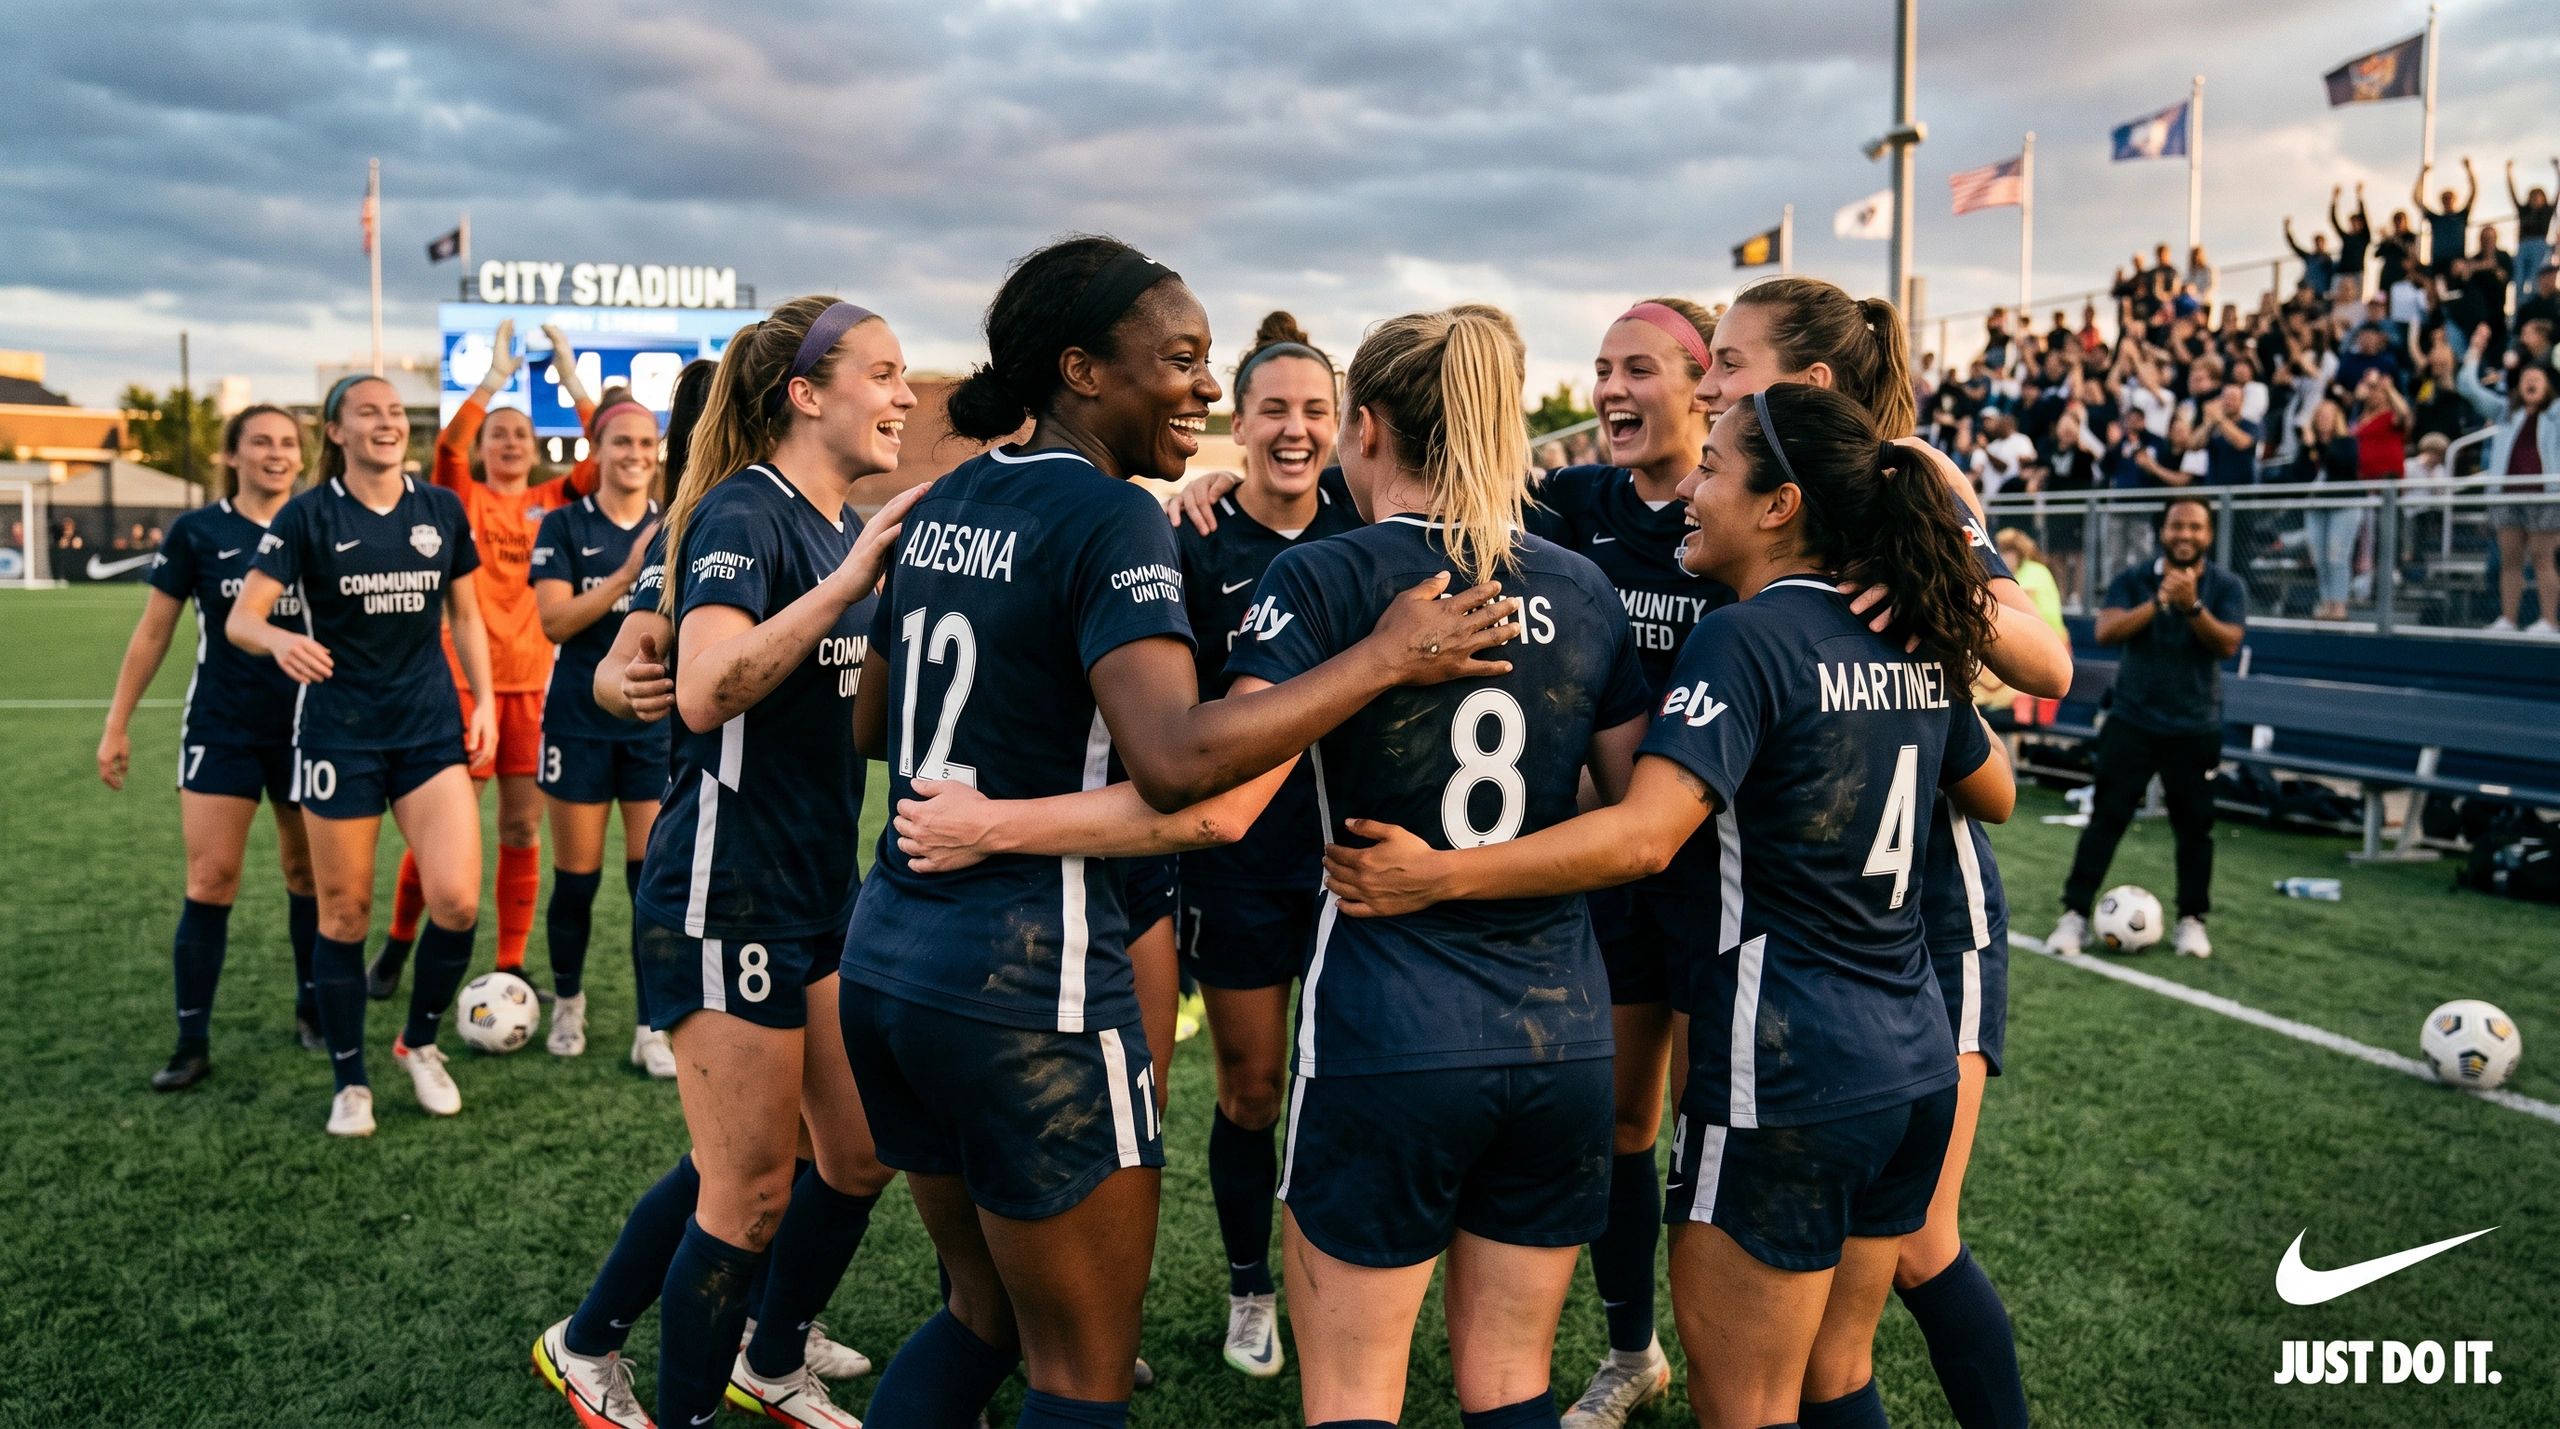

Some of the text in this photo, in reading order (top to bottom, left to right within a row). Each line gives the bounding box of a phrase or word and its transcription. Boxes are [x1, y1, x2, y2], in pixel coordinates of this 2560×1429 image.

[479, 260, 737, 309] CITY STADIUM
[692, 551, 755, 573] COMMUNITY
[900, 520, 1017, 582] ADESINA
[340, 571, 441, 596] COMMUNITY
[699, 565, 736, 583] UNITED
[1111, 564, 1182, 589] COMMUNITY
[1131, 582, 1179, 603] UNITED
[364, 592, 425, 615] UNITED
[1240, 595, 1295, 641] ely
[1616, 587, 1707, 624] MUNITY
[899, 607, 977, 790] 12
[1663, 680, 1728, 727] ely
[1817, 662, 1950, 712] MARTINEZ
[187, 746, 205, 780] 7
[303, 760, 337, 800] 10
[546, 746, 562, 783] 3
[1441, 688, 1526, 850] 8
[1862, 745, 1918, 910] 4
[739, 943, 771, 1003] 8
[1137, 1061, 1160, 1141] 1
